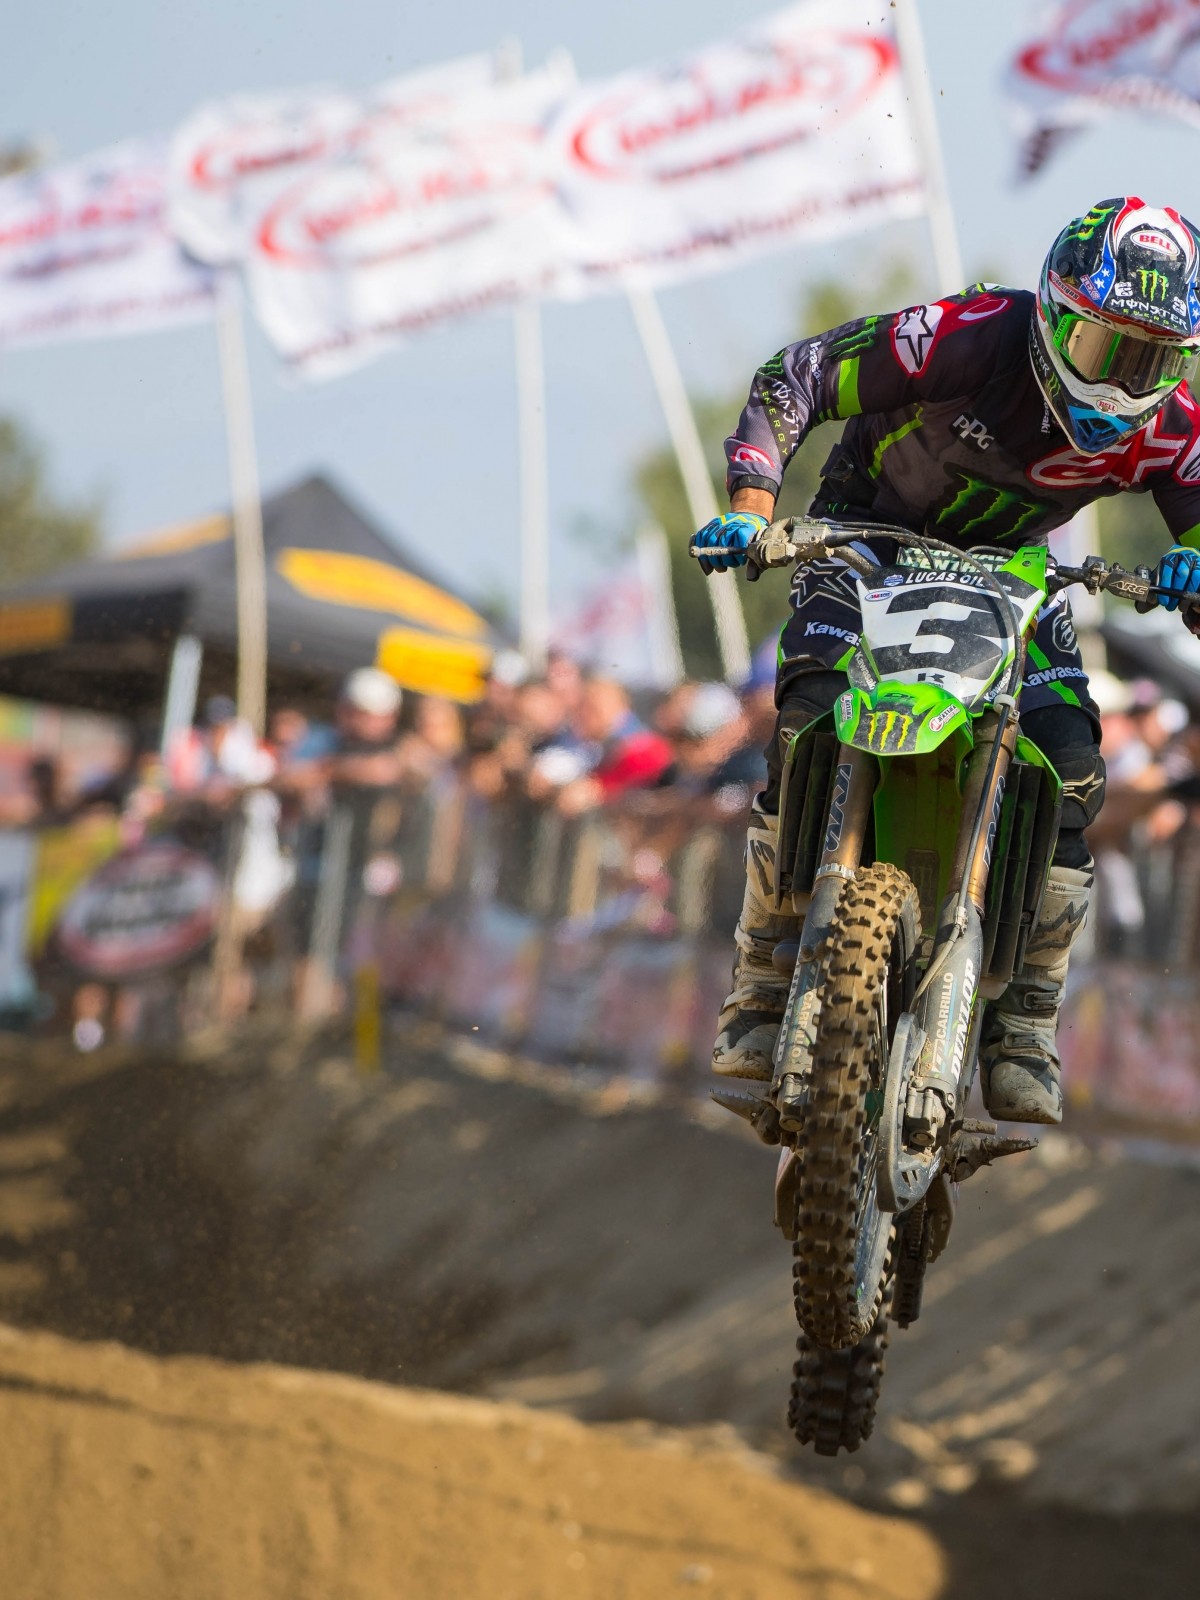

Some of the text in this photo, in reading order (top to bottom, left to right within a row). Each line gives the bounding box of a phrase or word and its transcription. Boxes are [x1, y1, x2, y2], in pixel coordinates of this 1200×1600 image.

[1139, 234, 1174, 252] BELL
[1111, 298, 1188, 331] MONSTER
[762, 390, 788, 455] ENERGY
[905, 571, 958, 584] LUCAS
[959, 574, 985, 588] OIL
[1109, 580, 1149, 595] ARC
[870, 586, 1025, 680] 3
[936, 972, 954, 1039] CARRILLO
[951, 958, 976, 1084] DUNLOP
